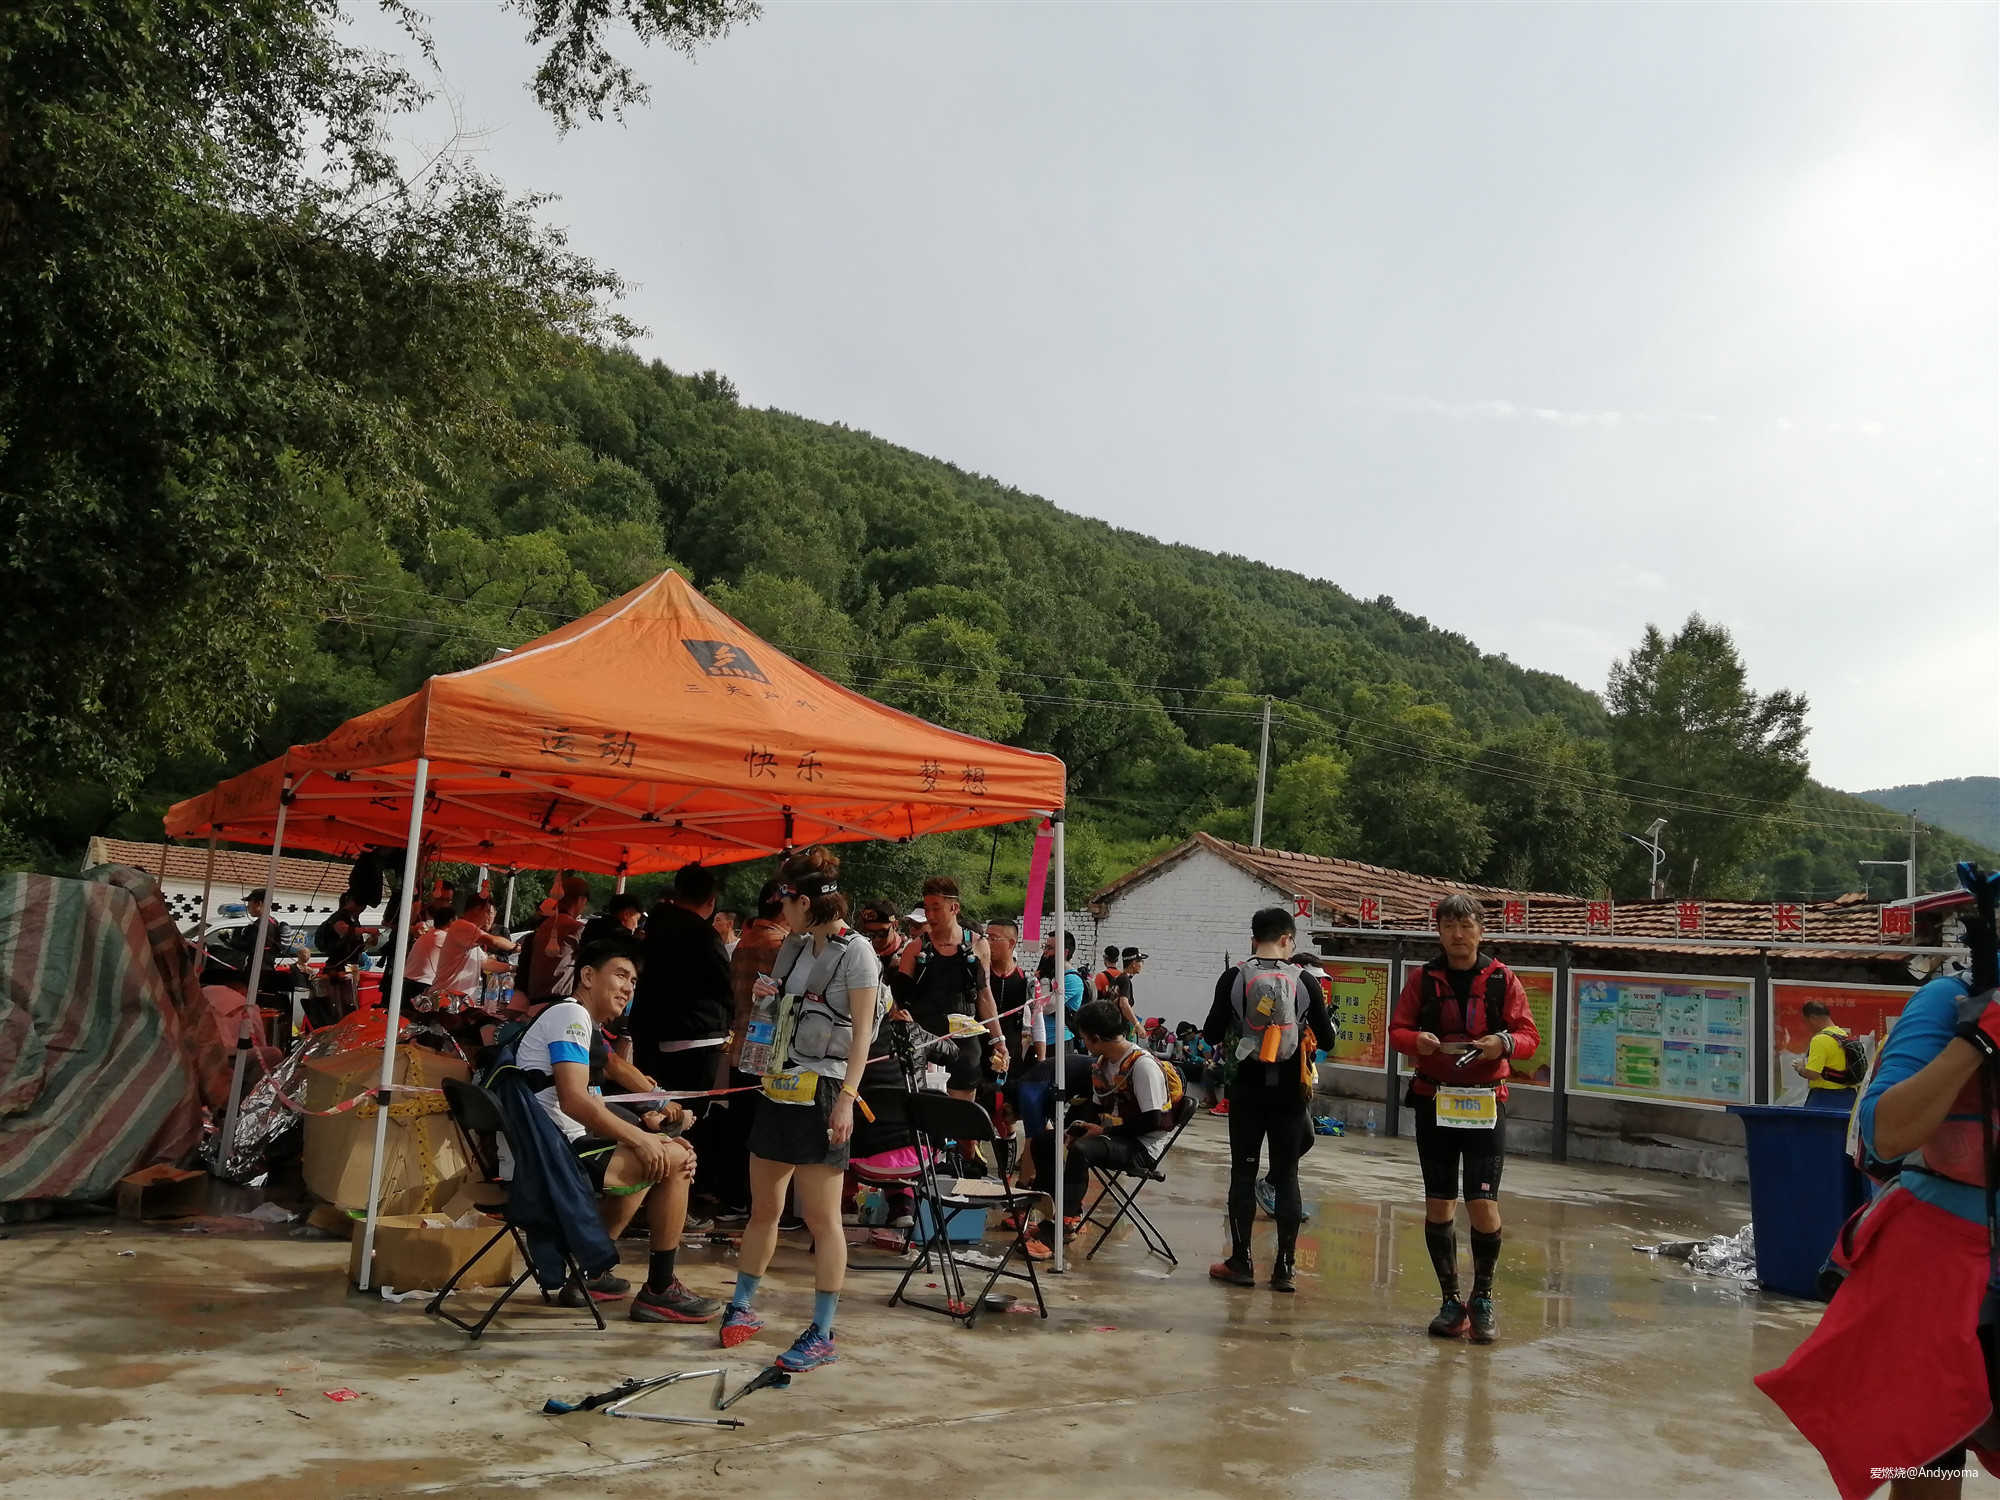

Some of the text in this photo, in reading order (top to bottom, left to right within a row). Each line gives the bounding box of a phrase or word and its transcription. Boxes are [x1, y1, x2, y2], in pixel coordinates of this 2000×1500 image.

[539, 728, 987, 796] 运动 快乐 梦想
[1293, 897, 1914, 935] 文化传科普长廊
[1453, 1098, 1481, 1111] 7165
